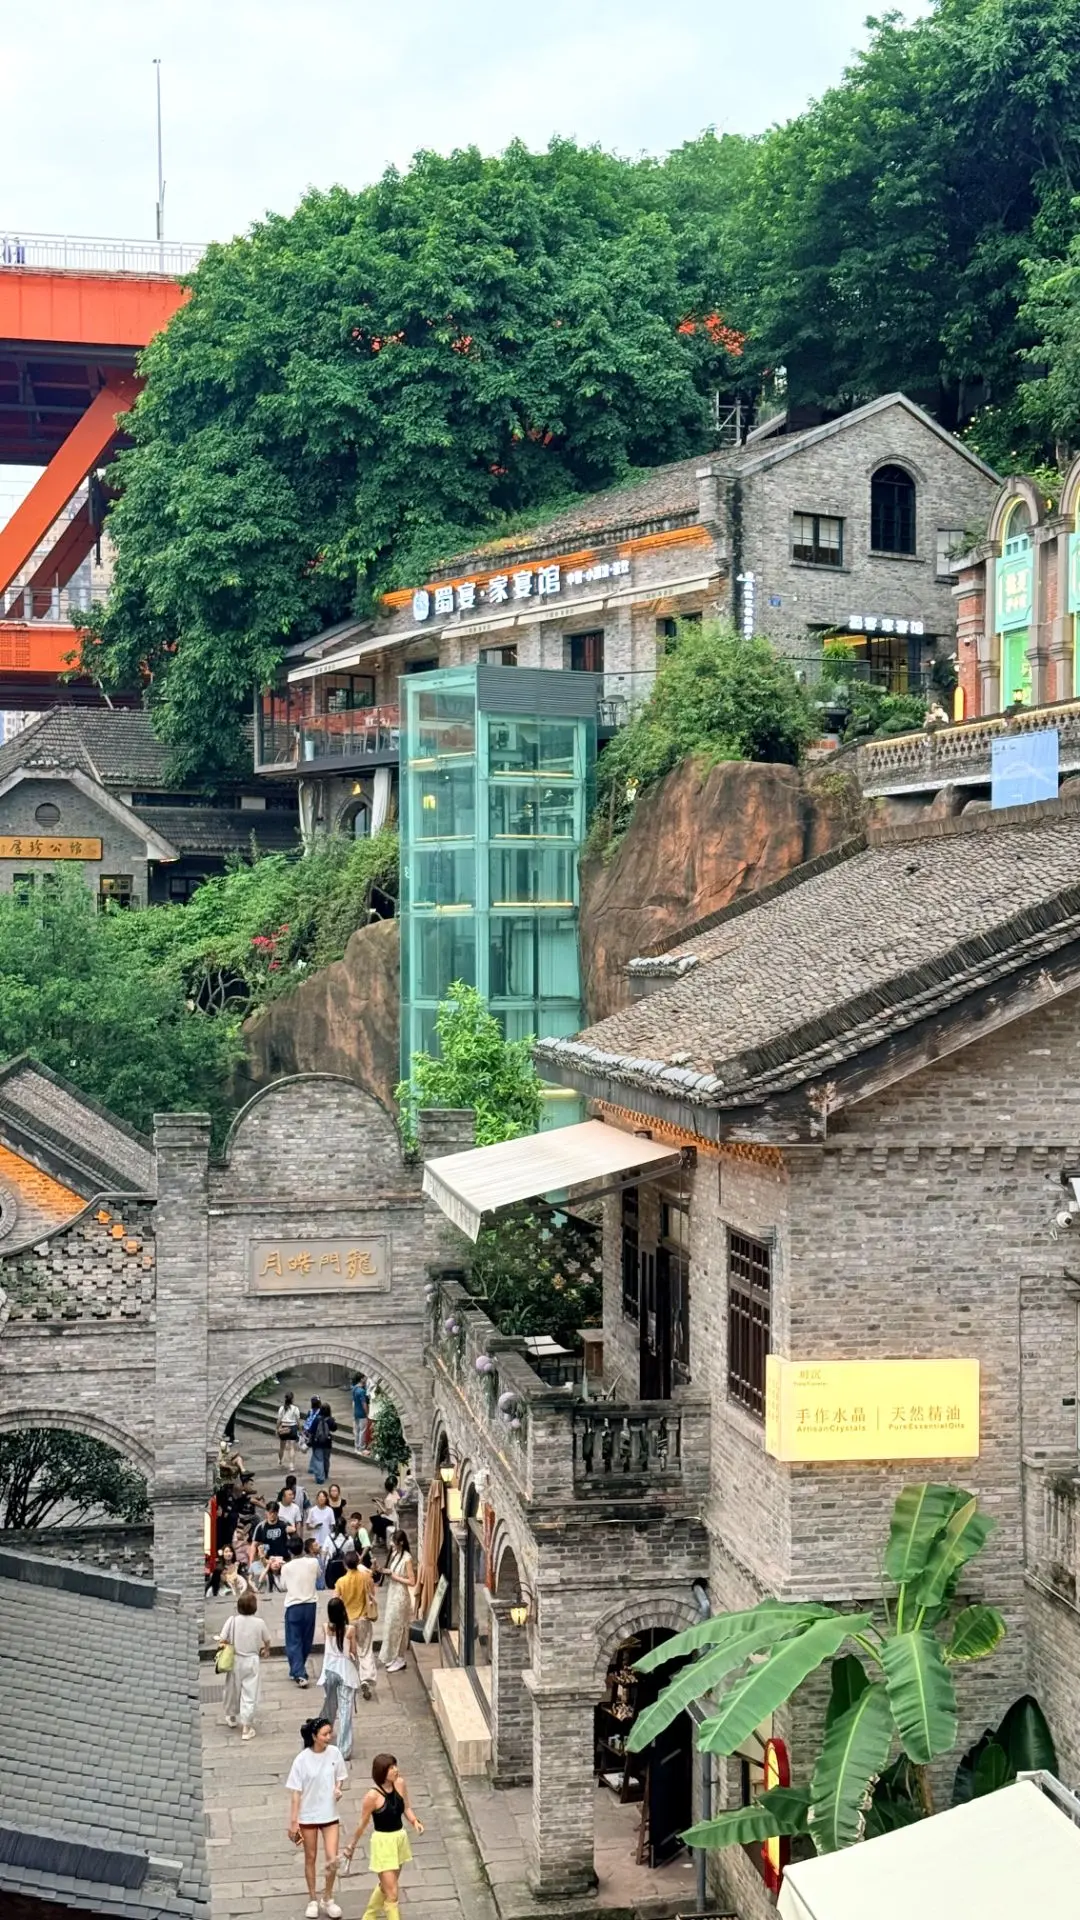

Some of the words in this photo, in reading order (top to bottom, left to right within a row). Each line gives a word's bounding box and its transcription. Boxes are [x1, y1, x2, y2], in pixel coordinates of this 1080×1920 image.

[795, 1407, 866, 1425] 手作水晶
[891, 1405, 961, 1422] 天然精油
